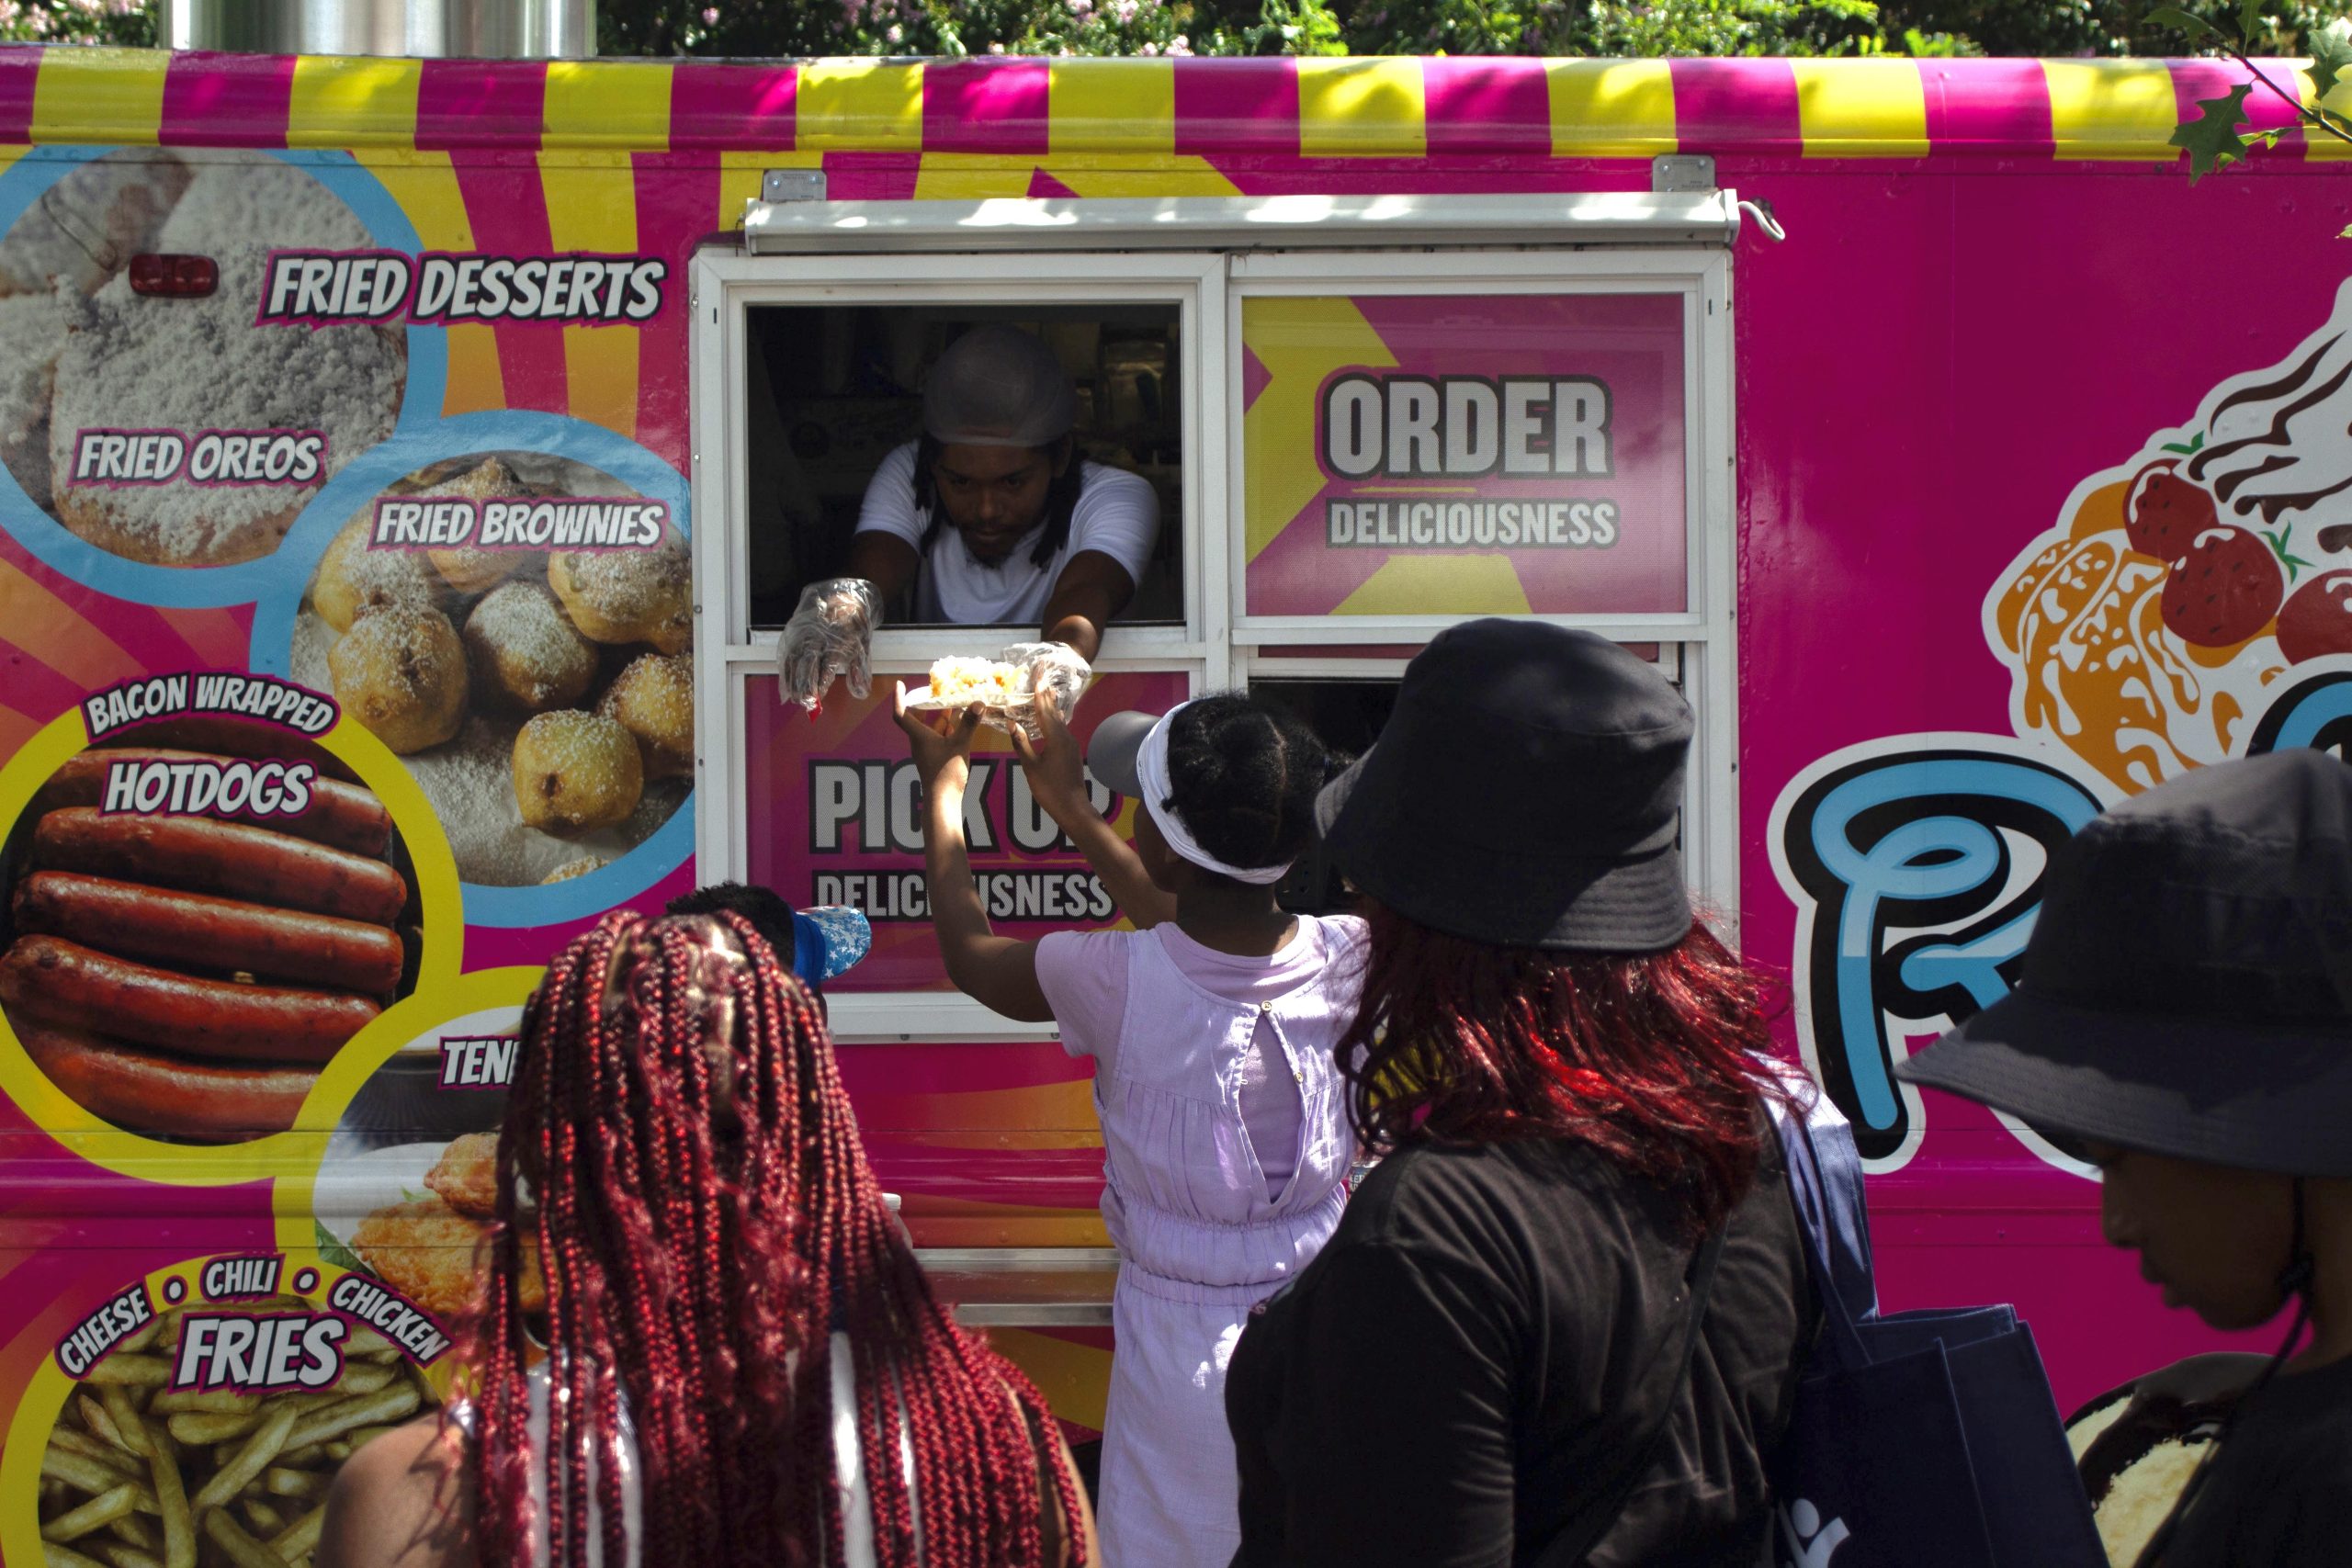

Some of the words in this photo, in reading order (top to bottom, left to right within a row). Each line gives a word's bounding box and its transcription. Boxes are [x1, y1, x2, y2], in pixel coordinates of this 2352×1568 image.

[267, 257, 408, 318] FRIED
[416, 259, 666, 319] DESSERTS
[1329, 378, 1608, 475] ORDER
[76, 435, 184, 479] FRIED
[190, 436, 322, 479] OREOS
[377, 505, 475, 542] FRIED
[481, 505, 663, 544] BROWNIES
[1330, 502, 1616, 545] DELICIOUSNESS
[86, 675, 187, 734] BACON
[196, 675, 334, 732] WRAPPED
[105, 762, 312, 814] HOTDOGS
[818, 874, 1114, 918] DELICUSNESS
[444, 1040, 520, 1085] TEN
[60, 1288, 149, 1375] CHEESE
[206, 1259, 278, 1295] CHILI
[334, 1278, 450, 1360] CHICKEN
[177, 1318, 343, 1386] FRIES
